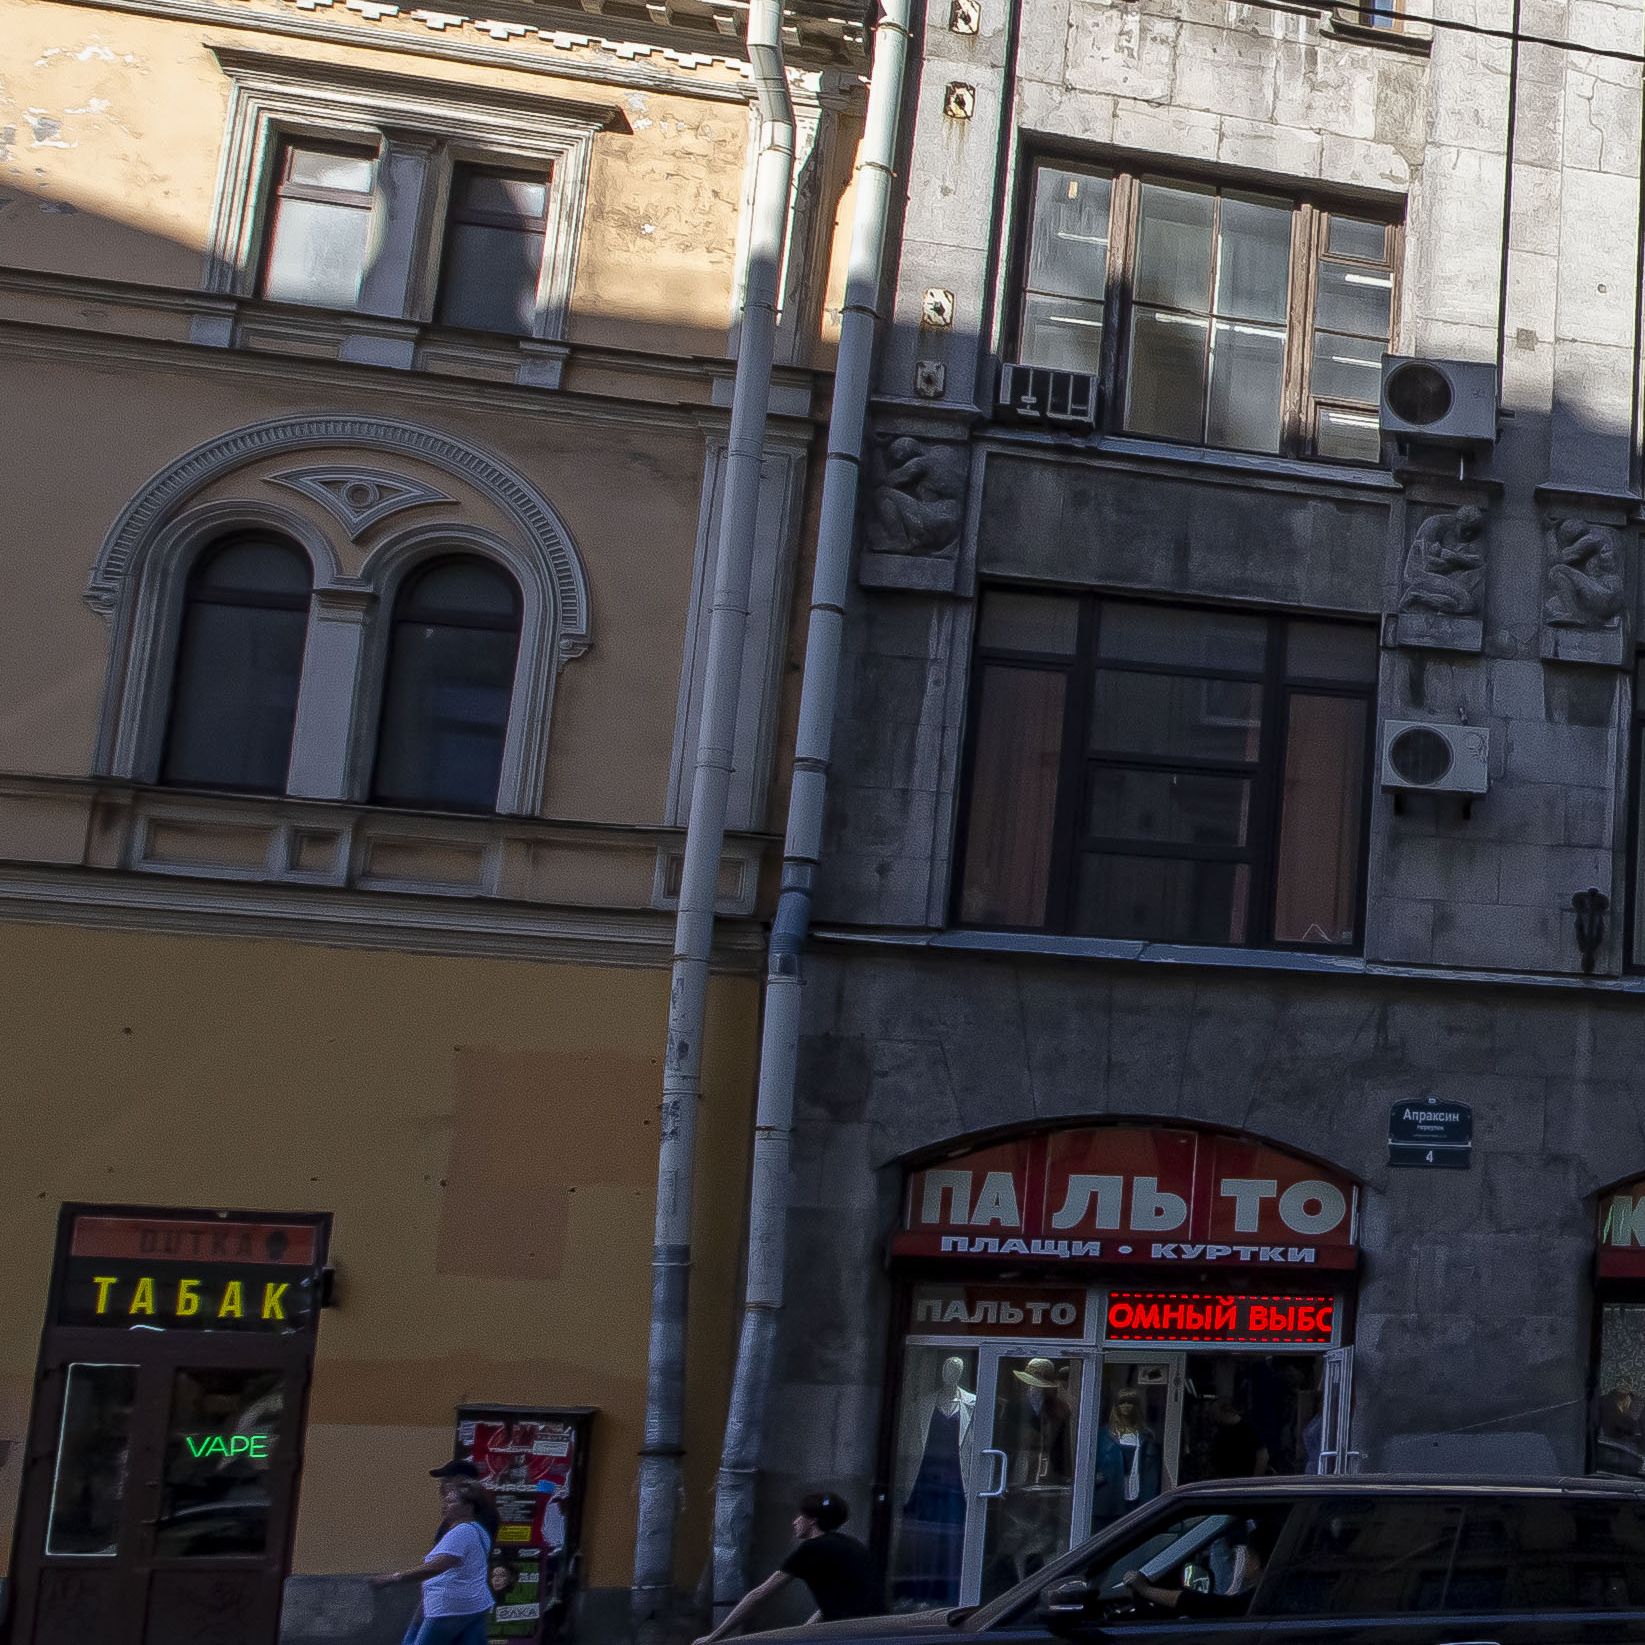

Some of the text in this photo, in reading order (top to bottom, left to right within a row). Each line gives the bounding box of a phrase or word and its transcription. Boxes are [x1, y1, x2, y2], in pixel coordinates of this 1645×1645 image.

[1402, 1108, 1460, 1123] Апраксин
[1425, 1150, 1434, 1163] 4
[920, 1169, 1347, 1235] ПАЛЬТО
[940, 1235, 1316, 1263] ПЛАЩИ КУРТКИ
[92, 1276, 290, 1320] ТАБАК
[915, 1298, 1077, 1326] ПАЛЬТО
[186, 1434, 269, 1458] VAPE
